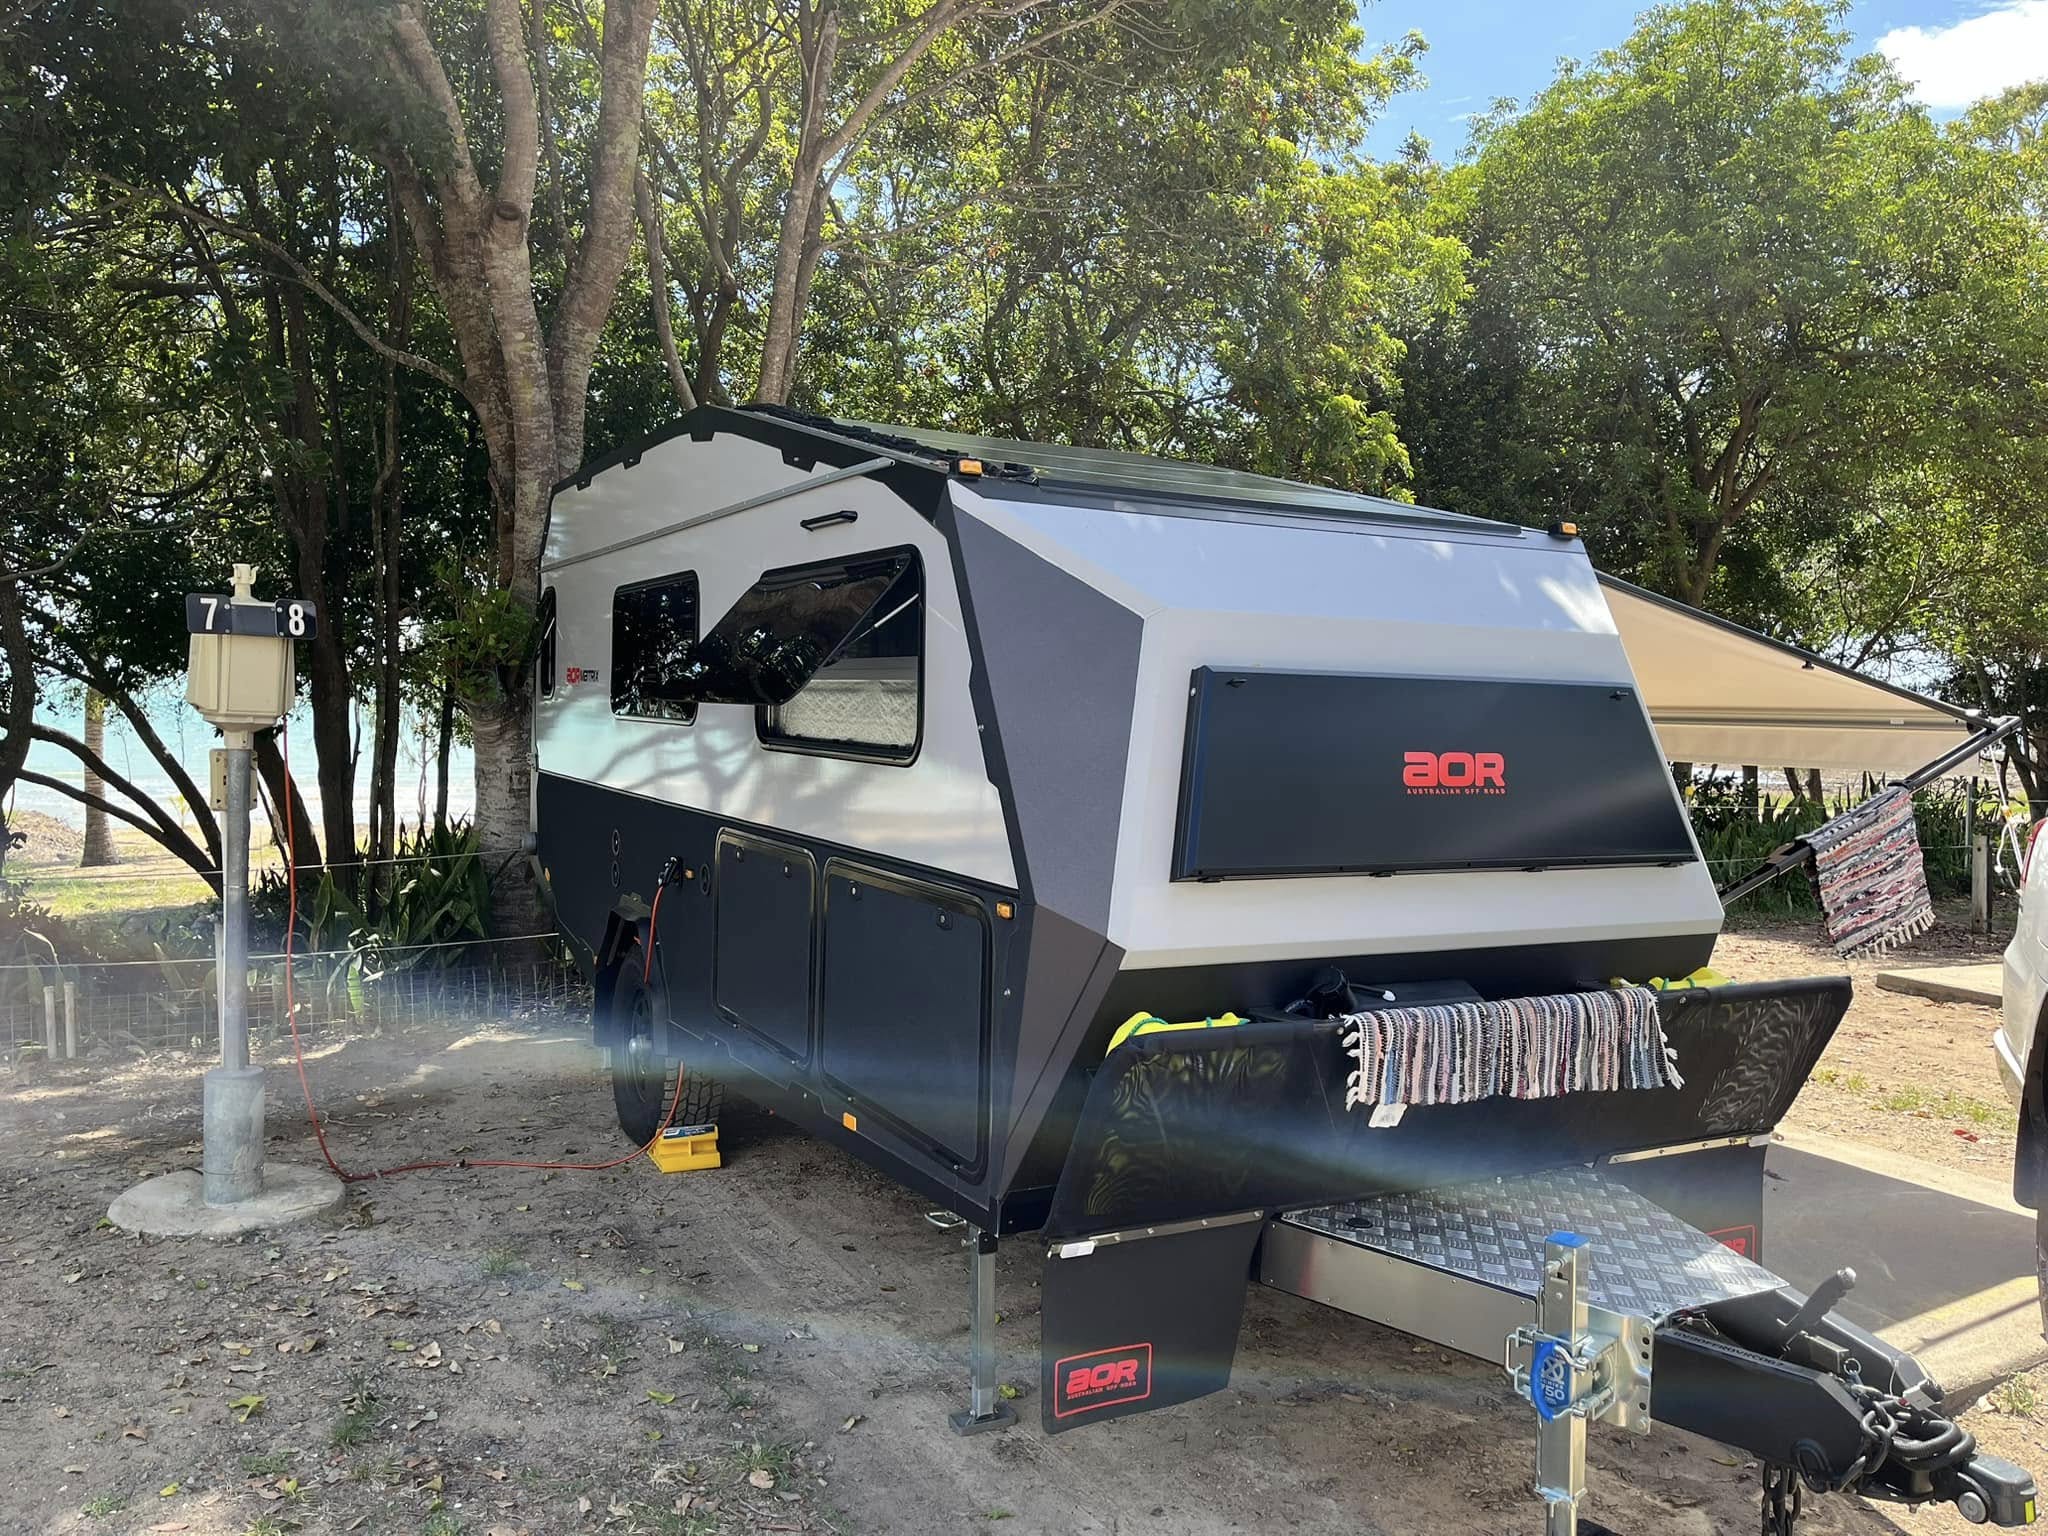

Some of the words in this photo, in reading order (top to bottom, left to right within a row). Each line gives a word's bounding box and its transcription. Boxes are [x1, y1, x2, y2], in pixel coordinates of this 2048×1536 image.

[200, 598, 218, 631] 7
[288, 603, 305, 636] 8
[1067, 1387, 1104, 1400] AUSTRALIAN
[1106, 1384, 1118, 1392] OFF
